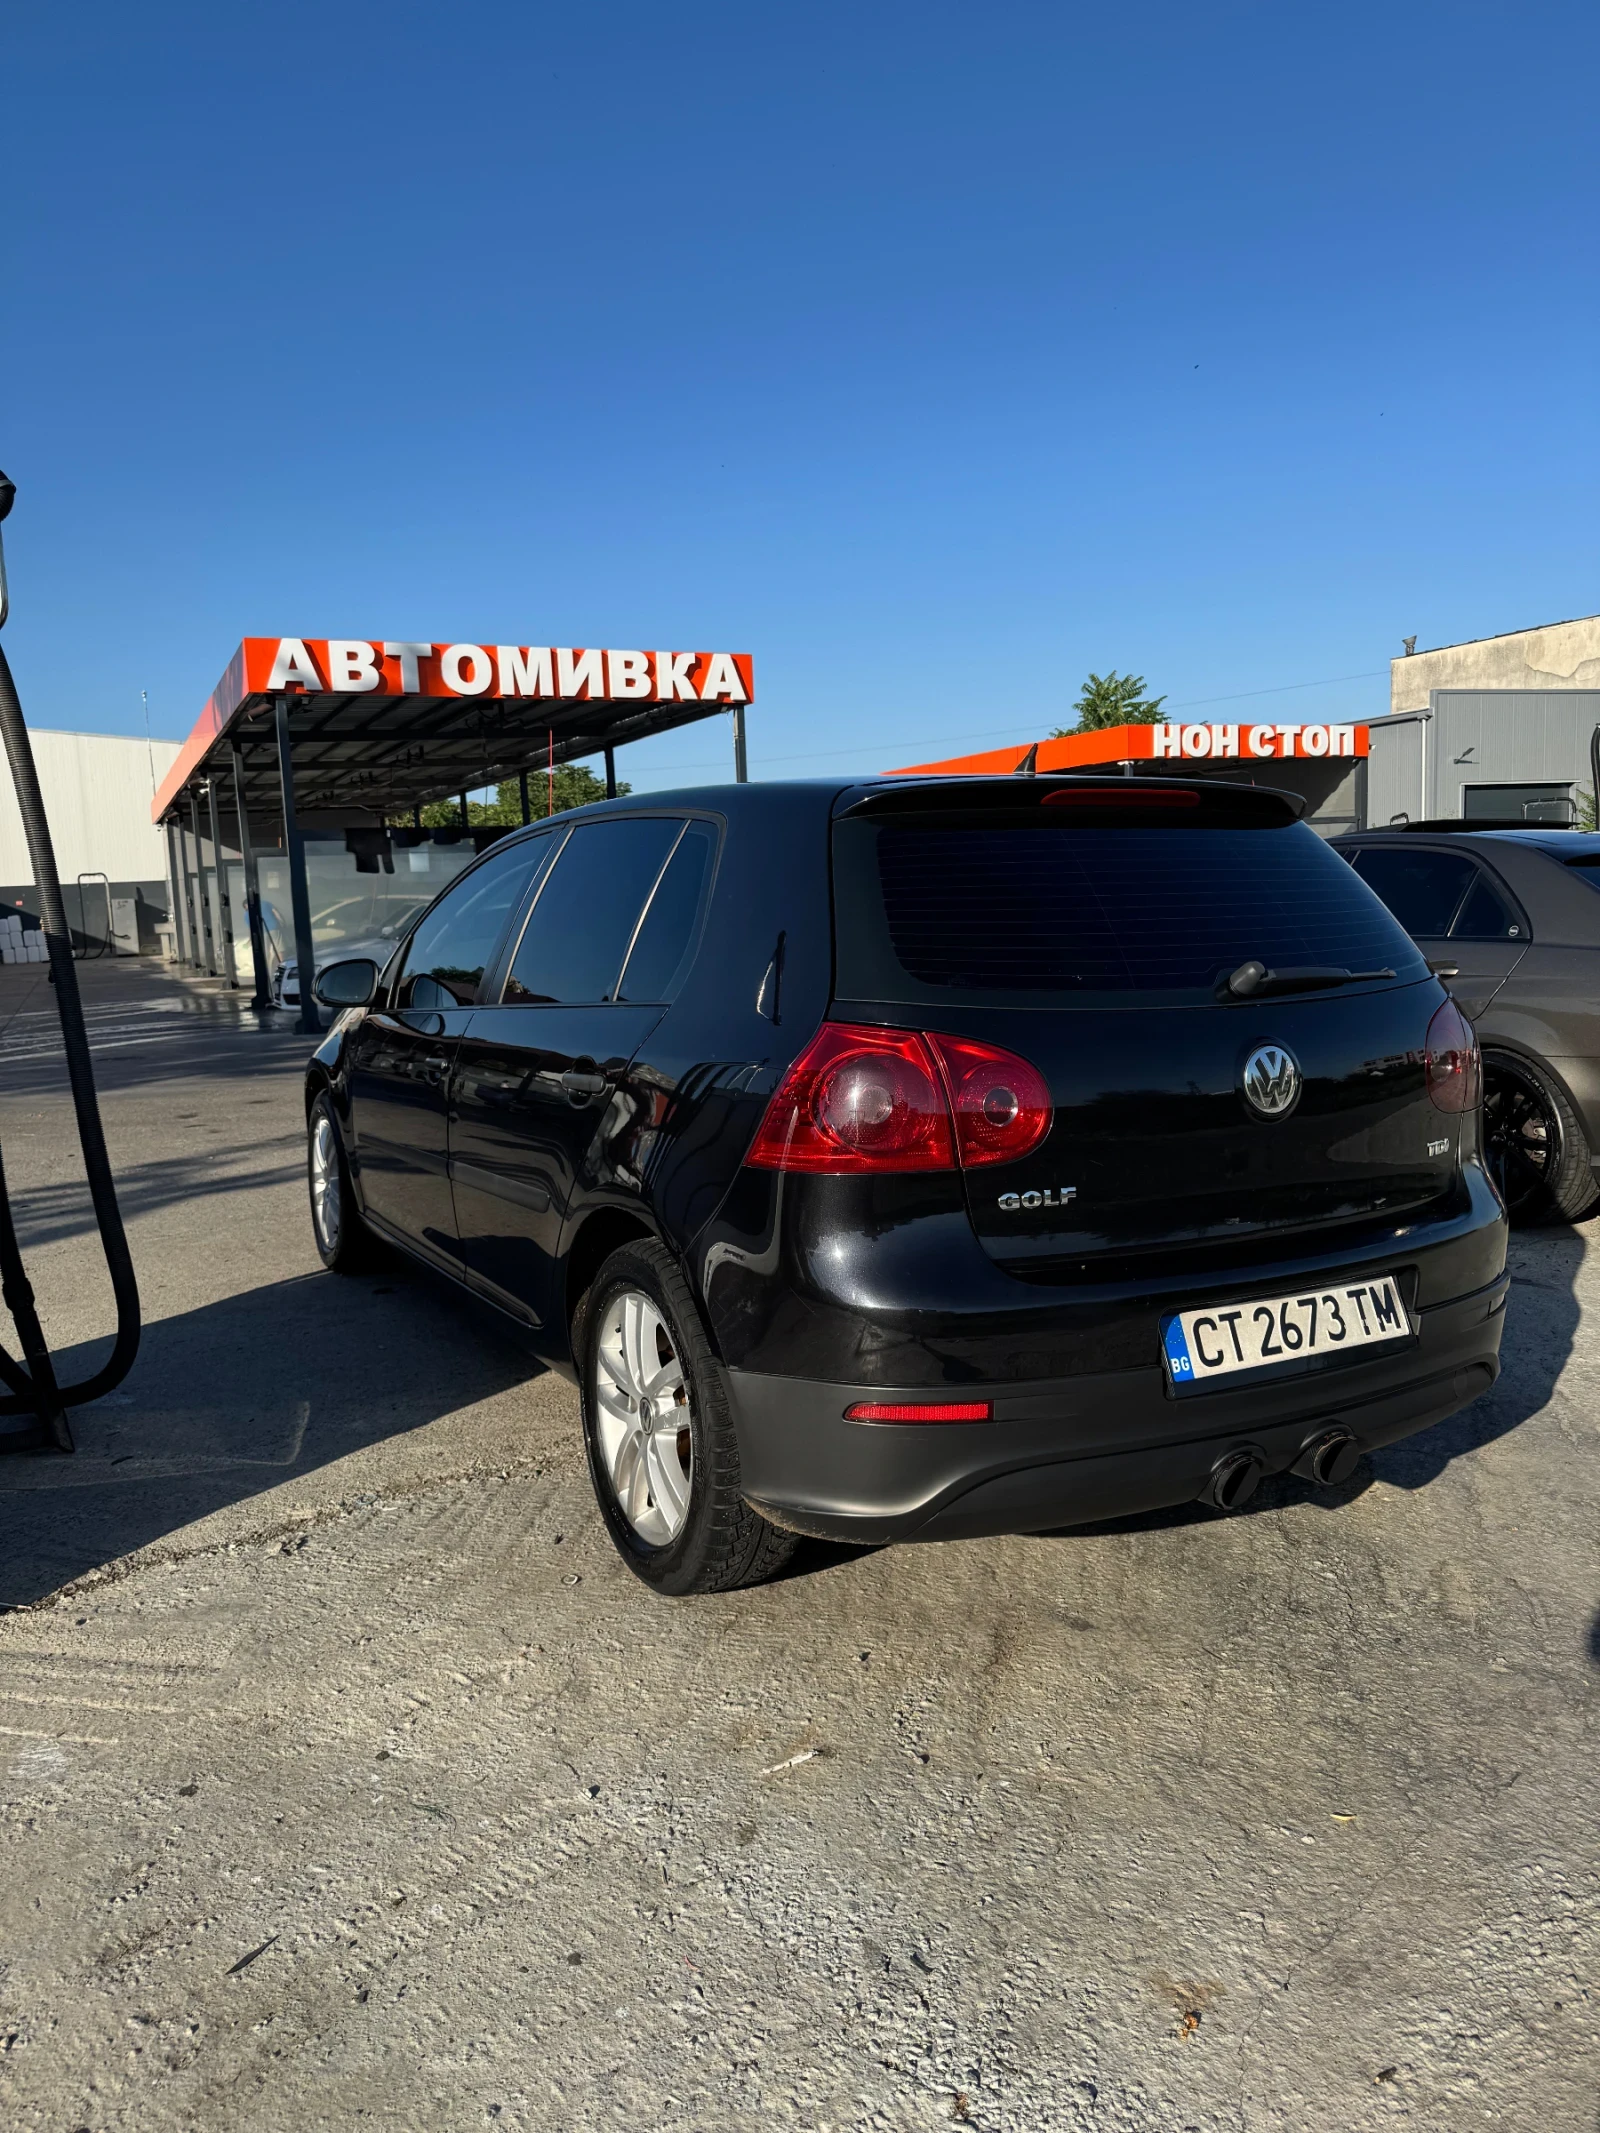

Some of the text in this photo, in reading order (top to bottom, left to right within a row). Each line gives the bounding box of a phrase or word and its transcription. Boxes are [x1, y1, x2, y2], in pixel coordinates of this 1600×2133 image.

[267, 637, 748, 700] АВТОМИВКА
[1153, 724, 1354, 758] НОН СТОП
[998, 1186, 1077, 1211] GOLF
[1192, 1283, 1402, 1368] CT 2673 TM
[1170, 1355, 1190, 1374] BG
